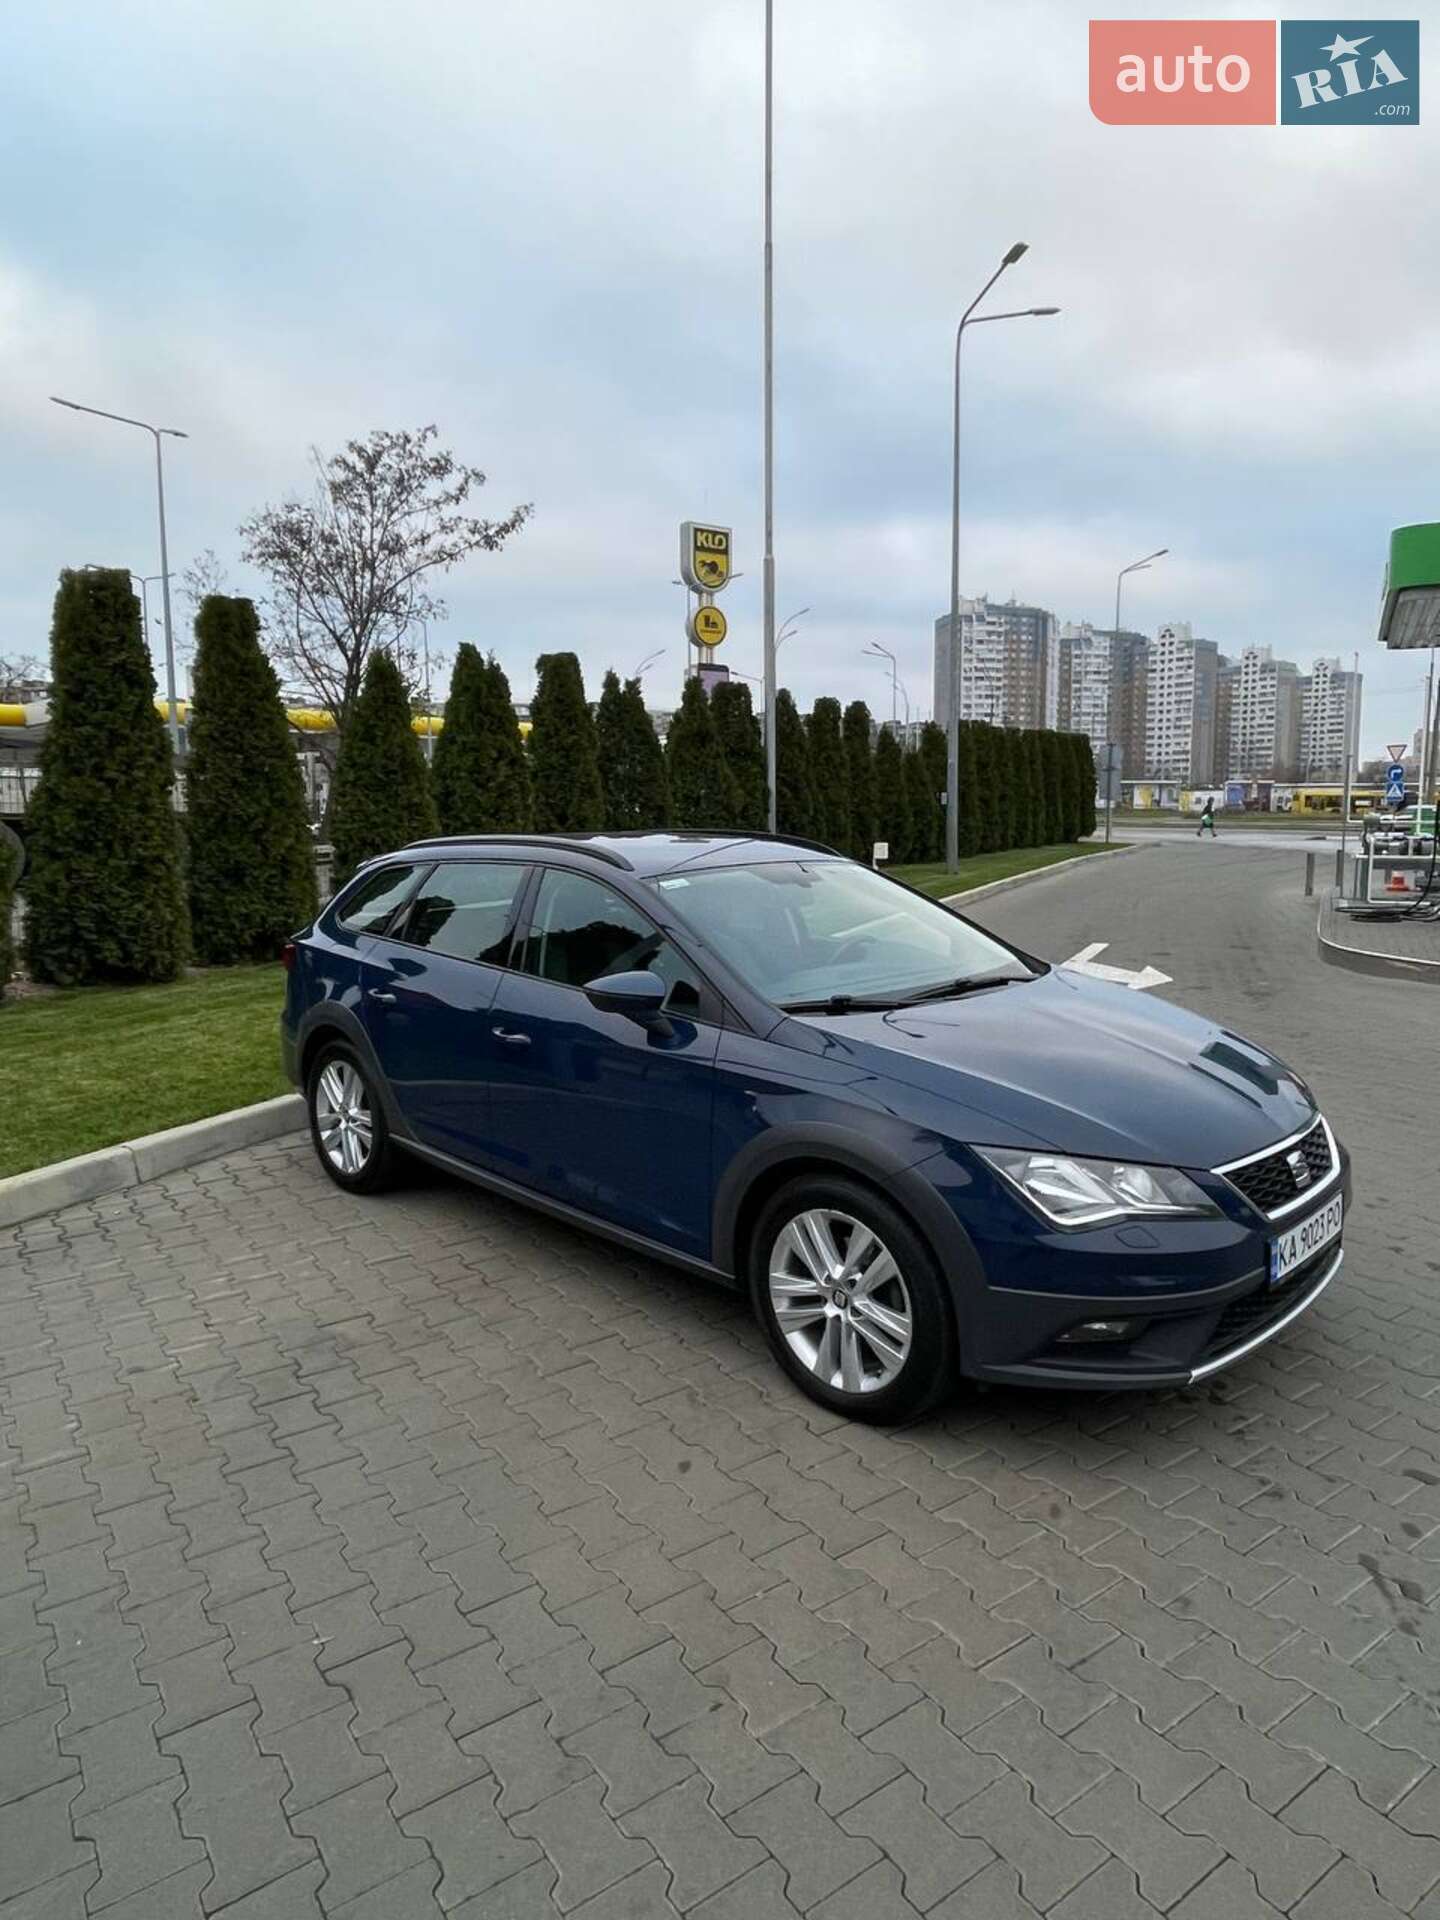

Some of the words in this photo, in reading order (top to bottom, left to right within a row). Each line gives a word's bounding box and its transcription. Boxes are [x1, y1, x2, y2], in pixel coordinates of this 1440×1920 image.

[696, 530, 727, 550] KLO
[1279, 1235, 1297, 1271] KA
[1300, 1213, 1325, 1254] 9023
[1327, 1201, 1341, 1235] PO
